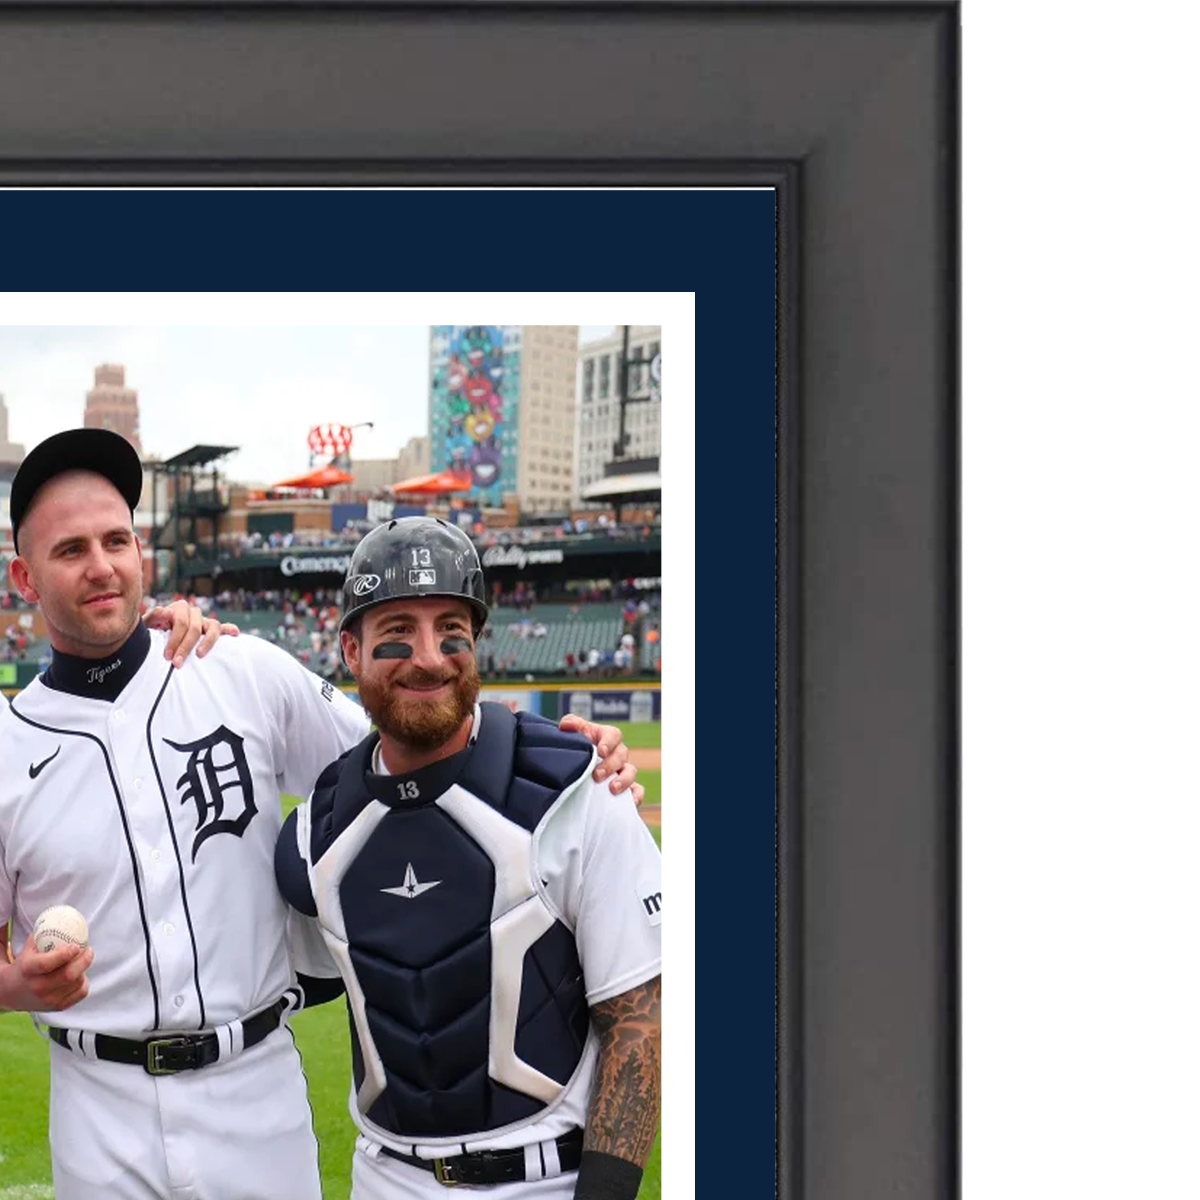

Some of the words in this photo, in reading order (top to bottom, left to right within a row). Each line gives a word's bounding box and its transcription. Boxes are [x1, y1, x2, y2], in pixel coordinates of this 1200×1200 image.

[411, 548, 432, 567] 13
[86, 659, 122, 683] Tigers
[397, 780, 420, 800] 13
